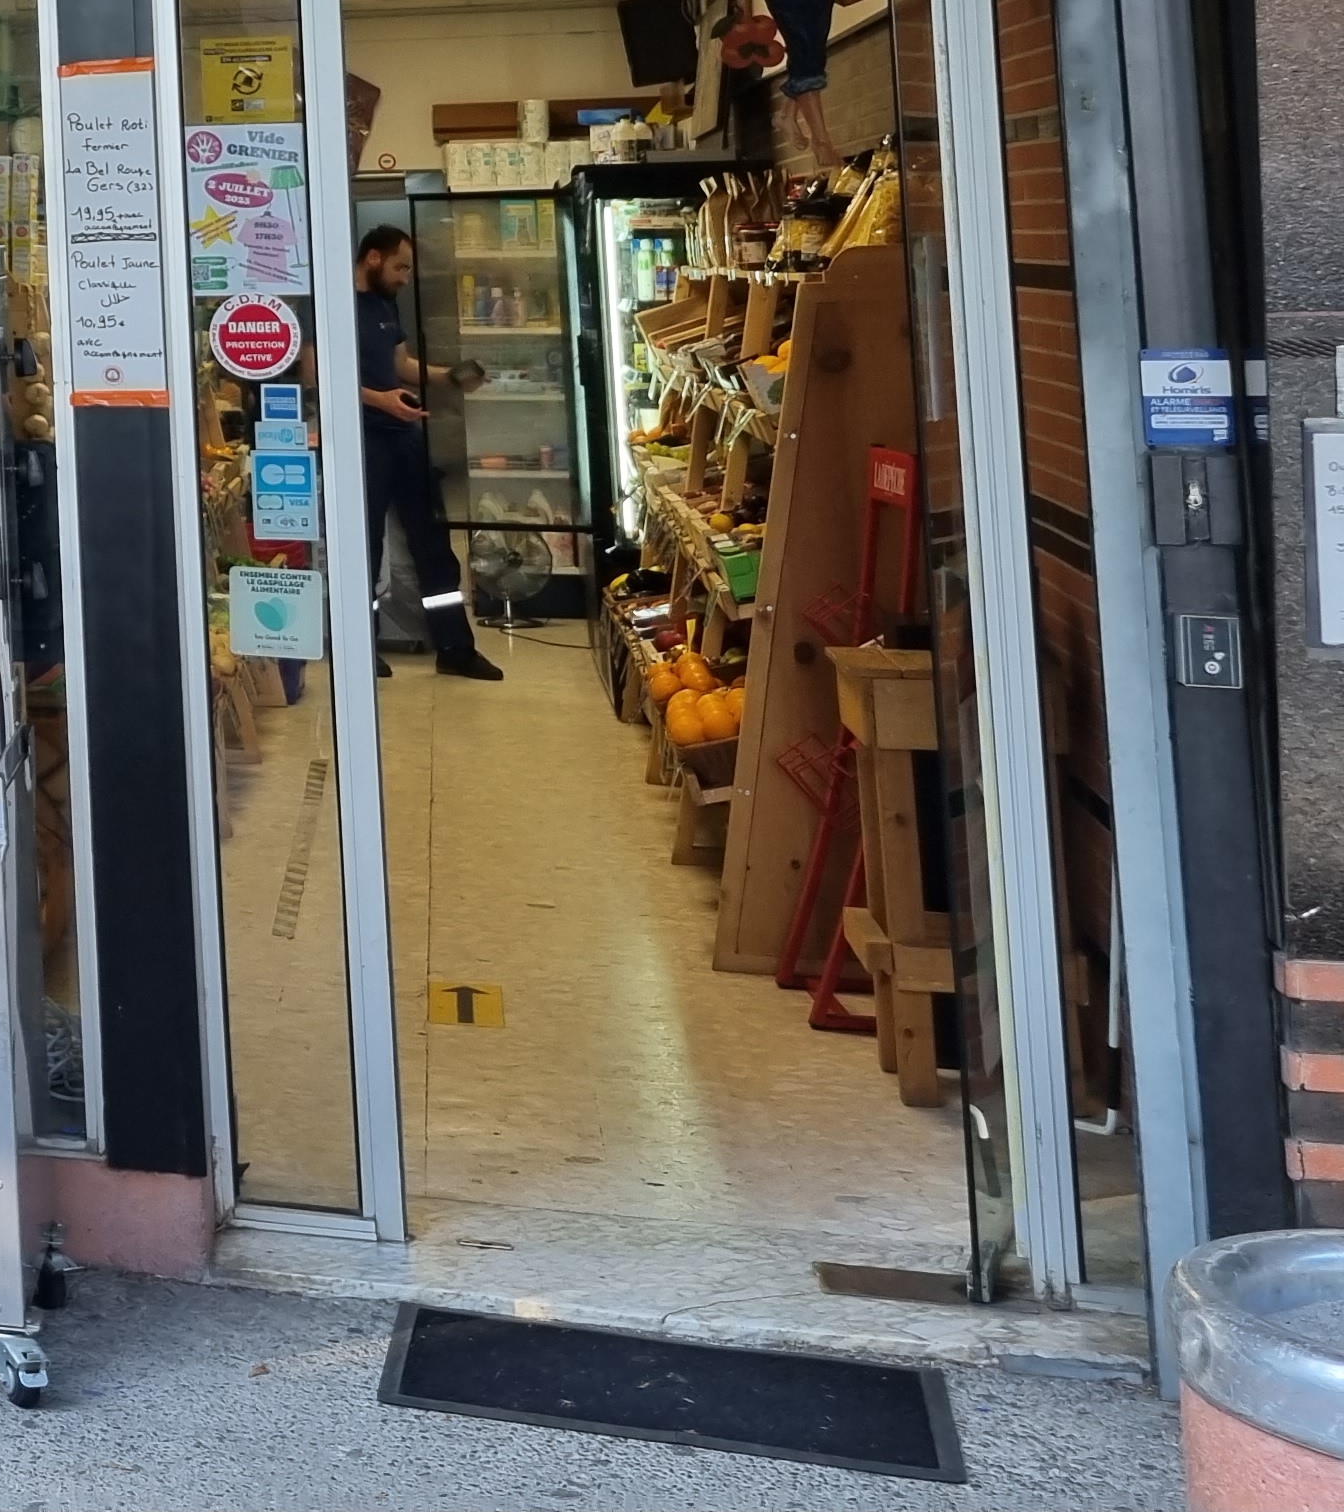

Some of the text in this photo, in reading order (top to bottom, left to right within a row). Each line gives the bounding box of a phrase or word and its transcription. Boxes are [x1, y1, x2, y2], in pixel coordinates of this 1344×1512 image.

[67, 112, 148, 131] Poulet Roti
[247, 130, 285, 144] Vide
[82, 137, 129, 151] Fermier
[226, 144, 299, 163] GRENIER
[65, 158, 81, 174] La
[86, 161, 109, 176] Bel
[87, 177, 153, 194] Gers (32)
[207, 179, 270, 197] 2 JUILLET
[224, 194, 250, 204] 2023
[71, 251, 160, 270] Poulet Jaune
[228, 321, 280, 333] DANGER
[77, 338, 103, 347] avec
[225, 341, 285, 349] PROTECTION
[239, 353, 273, 362] ACTIVE
[288, 498, 310, 507] VISA
[239, 571, 312, 582] ENSEMBLE CONTRE
[256, 579, 305, 588] GASPILLAGE
[250, 587, 301, 595] ALIMENTAIRE
